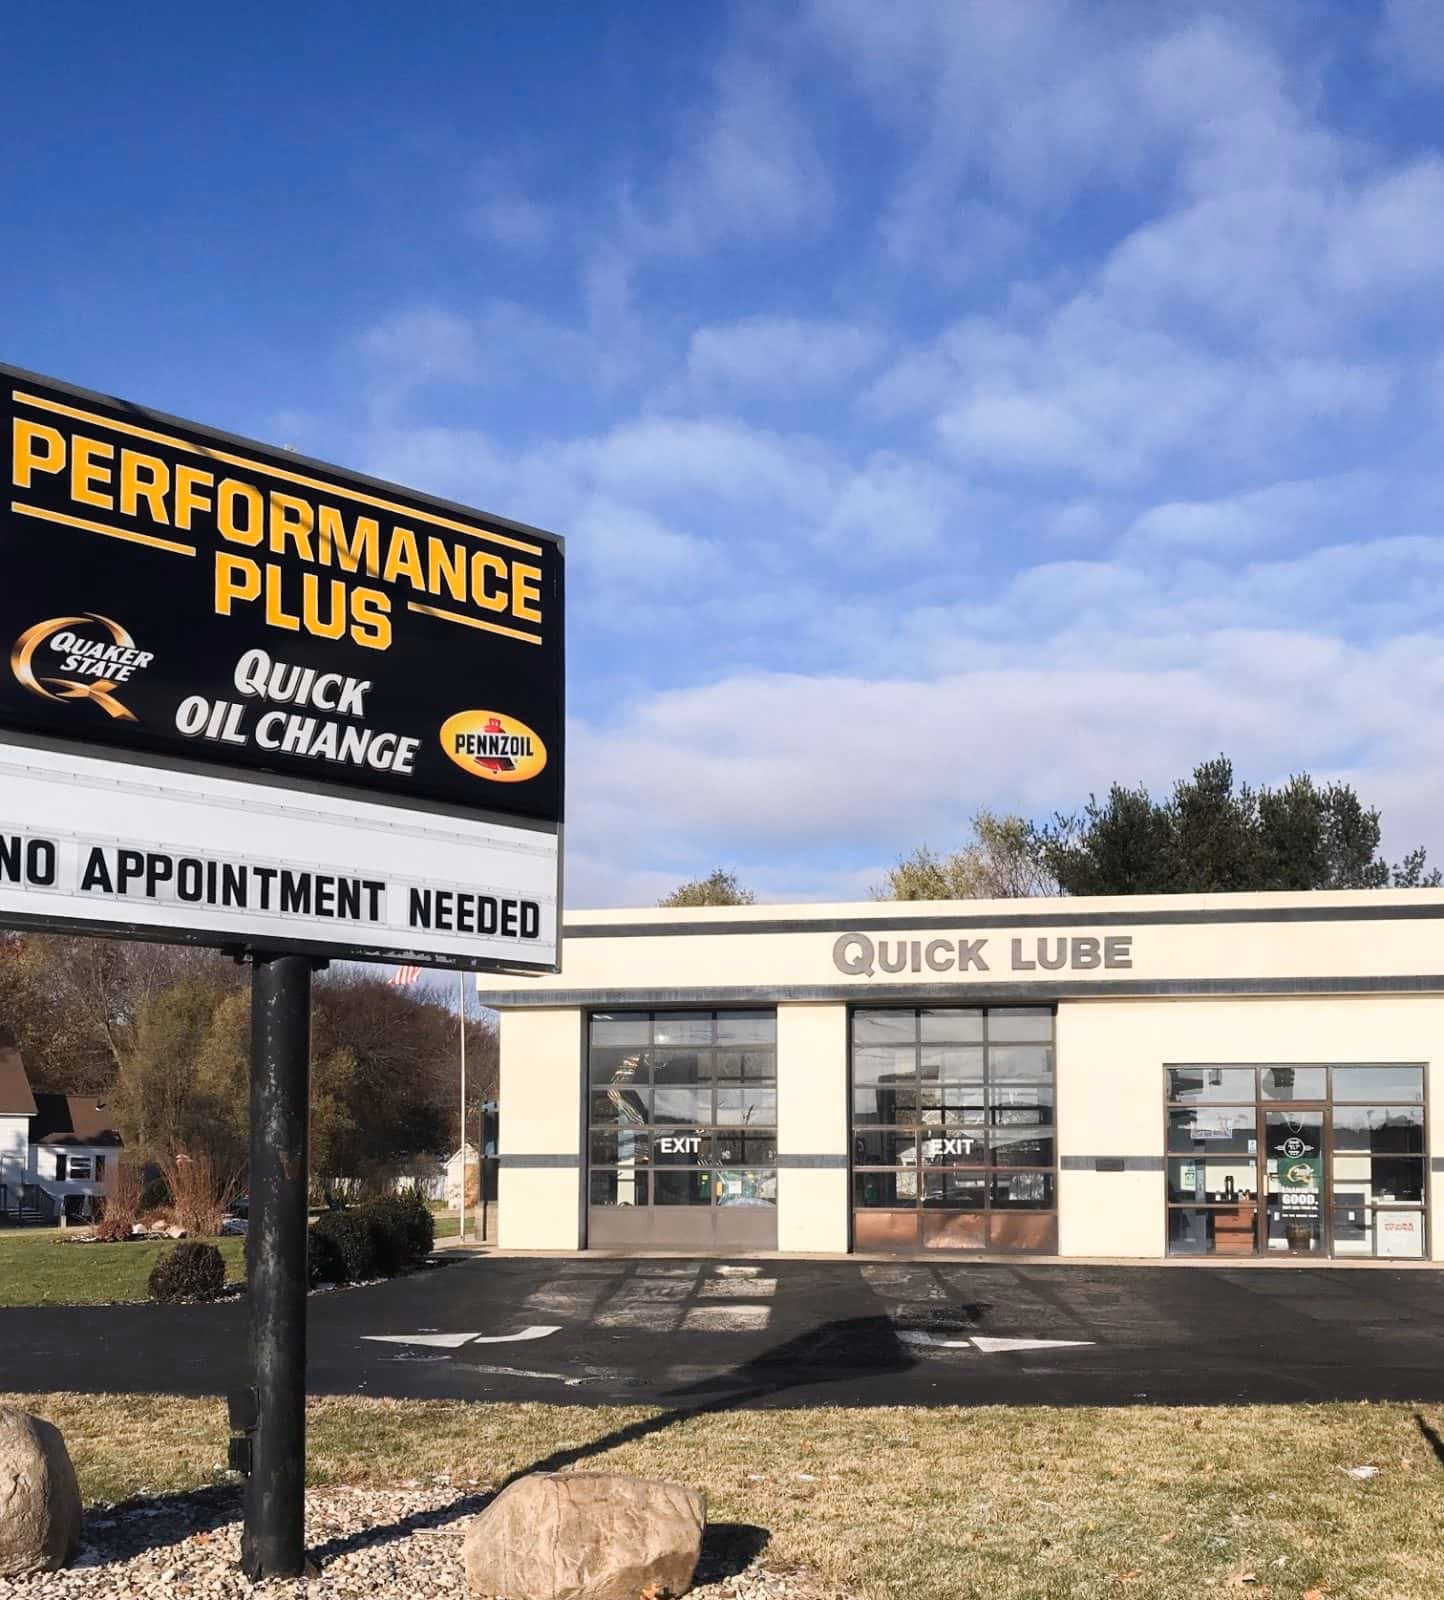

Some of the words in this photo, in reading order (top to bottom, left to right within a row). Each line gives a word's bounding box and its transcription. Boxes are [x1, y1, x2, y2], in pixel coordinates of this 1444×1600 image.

[12, 416, 543, 624] PERFORMANCE
[214, 551, 392, 651] PLUS
[50, 631, 154, 668] QUAKER
[59, 655, 136, 682] STATE
[234, 649, 372, 717] QUICK
[175, 695, 249, 744] OIL
[255, 711, 421, 774] CHANGE
[455, 733, 534, 757] PENNZOIL
[0, 834, 56, 886] NO
[80, 847, 386, 922] APPOINTMENT
[409, 887, 540, 939] NEEDED
[832, 932, 990, 978] QUICK
[1011, 936, 1133, 971] LUBE
[660, 1137, 702, 1153] EXIT
[930, 1139, 974, 1155] EXIT
